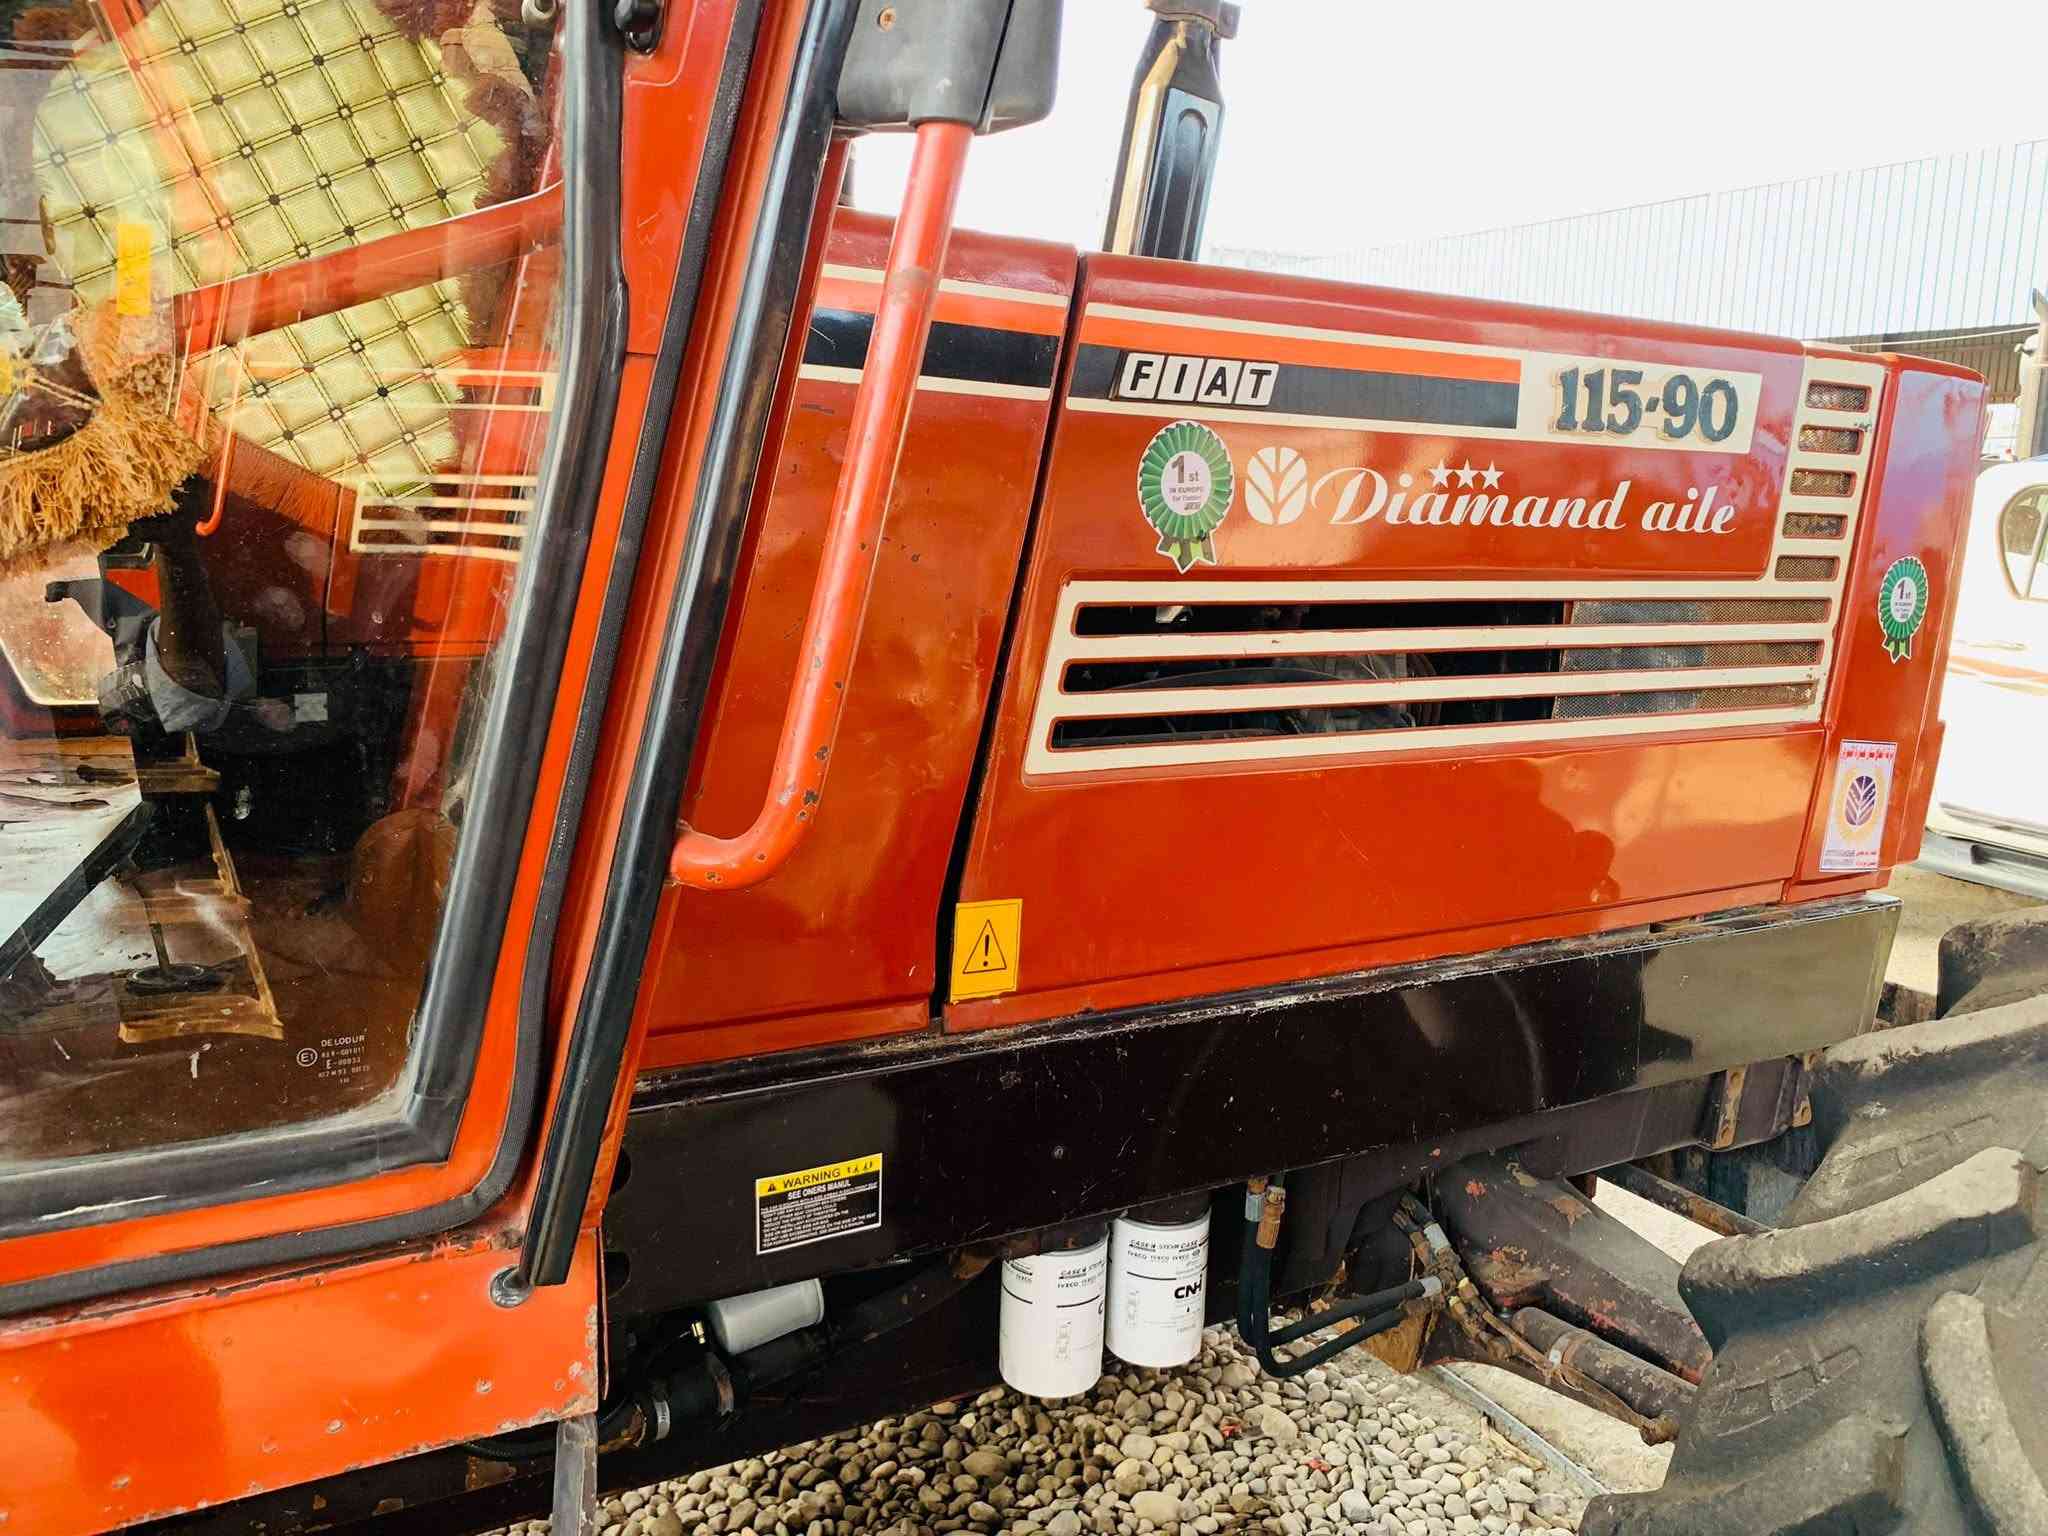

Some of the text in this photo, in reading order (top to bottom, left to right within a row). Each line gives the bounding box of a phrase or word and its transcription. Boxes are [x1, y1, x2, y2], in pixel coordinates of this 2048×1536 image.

[1129, 359, 1273, 399] FIAT
[1555, 366, 1739, 443] 115-90
[1310, 467, 1738, 535] Diamand aile
[783, 1168, 841, 1188] WARNING
[787, 1190, 803, 1201] SEE
